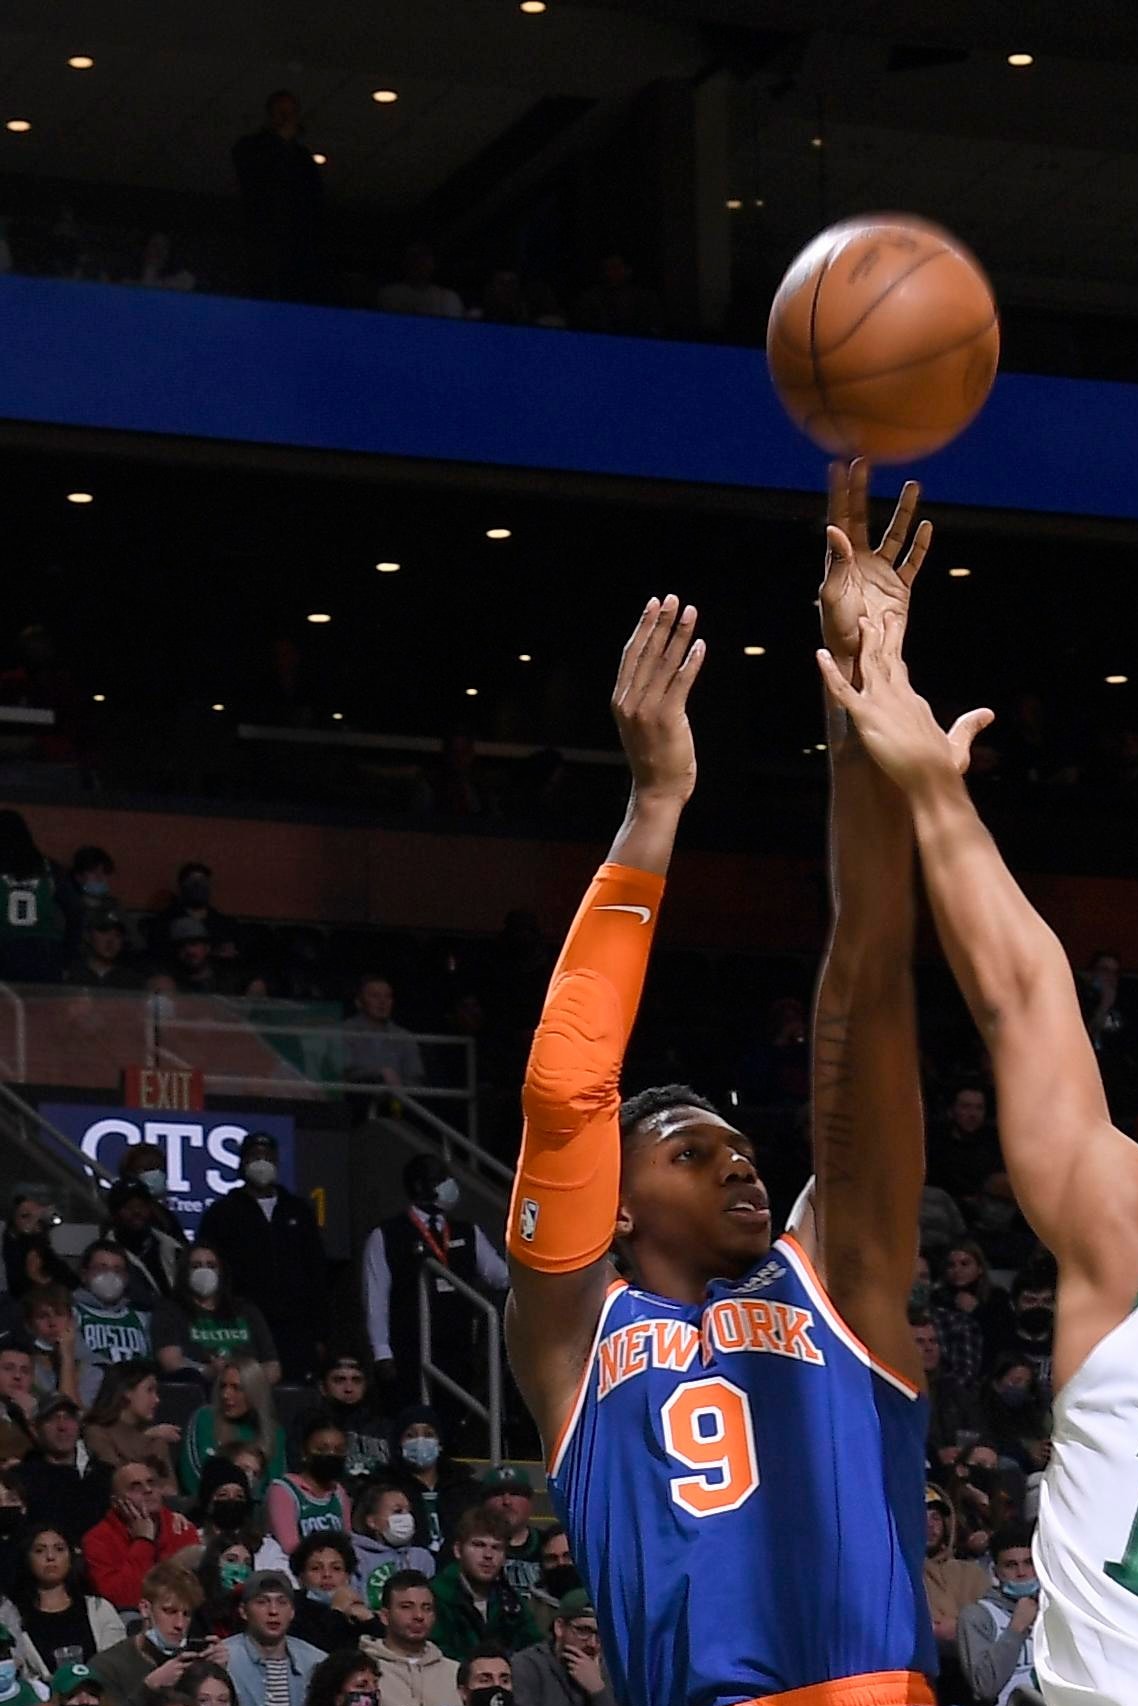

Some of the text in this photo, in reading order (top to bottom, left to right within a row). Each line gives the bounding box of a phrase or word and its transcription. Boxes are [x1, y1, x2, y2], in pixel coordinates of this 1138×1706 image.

[139, 1070, 193, 1109] EXIT
[597, 1318, 701, 1402] NEW
[660, 1375, 760, 1518] 9
